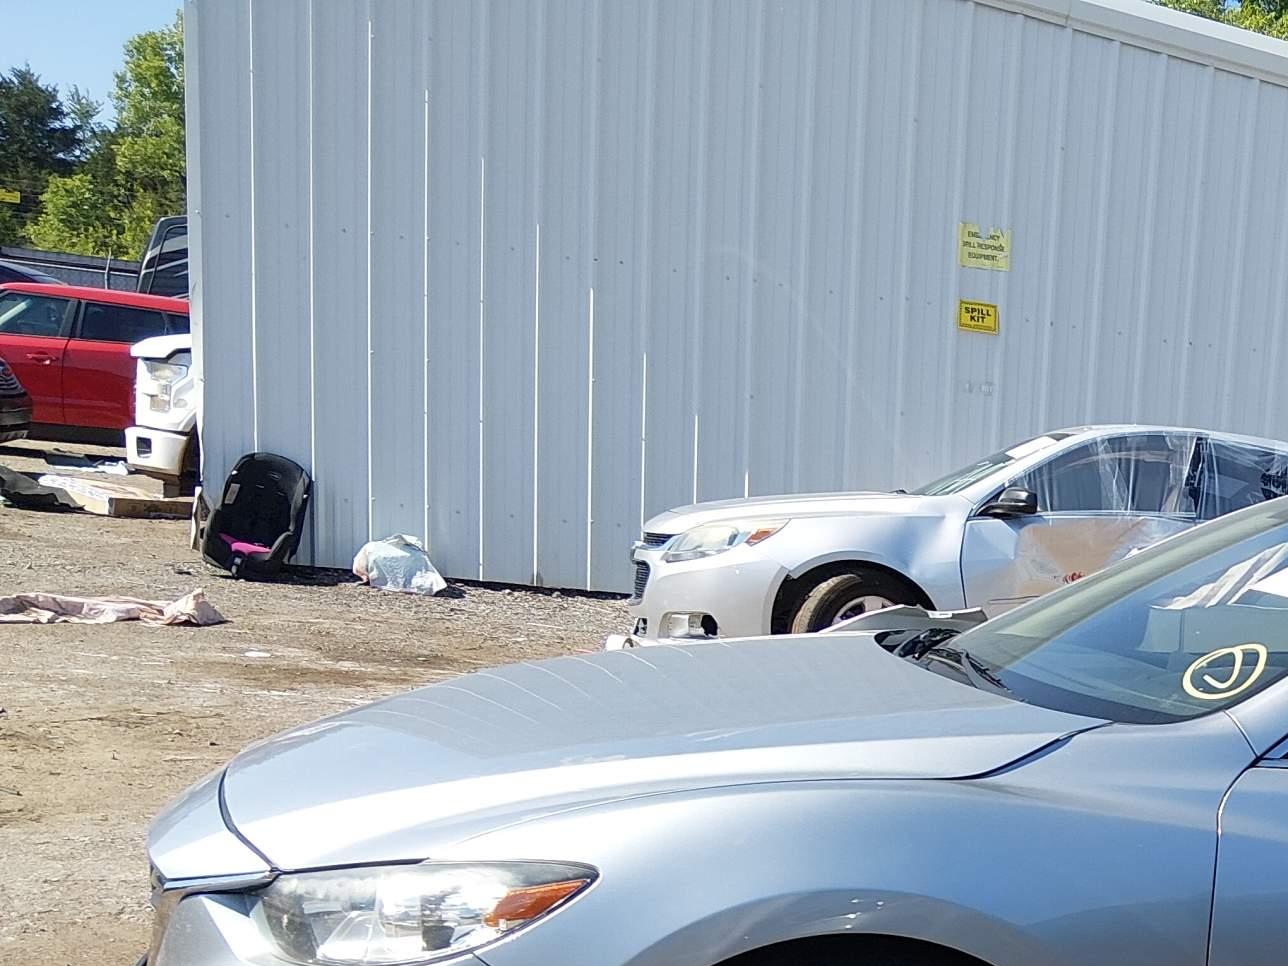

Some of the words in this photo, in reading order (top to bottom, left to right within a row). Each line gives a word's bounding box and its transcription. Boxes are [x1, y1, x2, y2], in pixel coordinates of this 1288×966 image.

[962, 240, 976, 248] SPILL
[965, 307, 992, 317] SPILL
[970, 314, 986, 324] KIT
